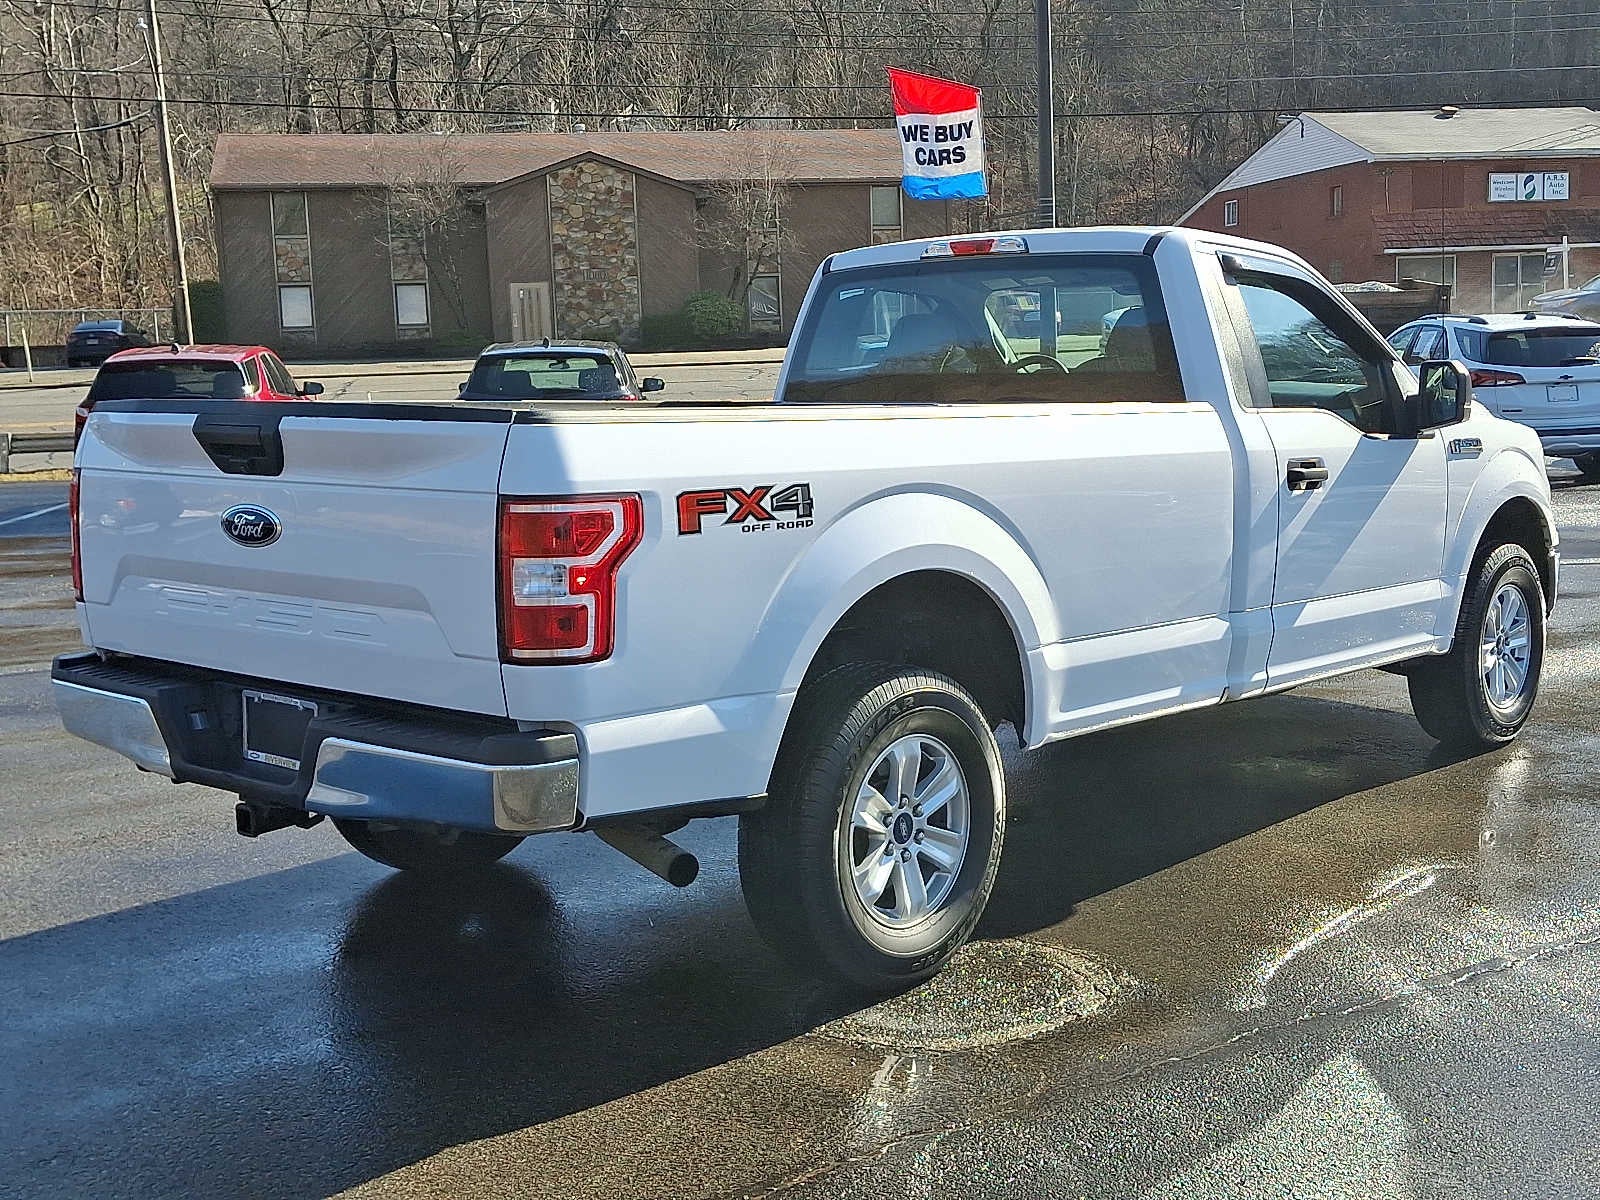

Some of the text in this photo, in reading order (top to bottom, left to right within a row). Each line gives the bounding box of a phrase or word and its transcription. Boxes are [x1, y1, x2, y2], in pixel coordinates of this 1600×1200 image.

[901, 120, 974, 143] WE BUY
[914, 145, 966, 166] CARS
[676, 483, 814, 535] FX4
[231, 513, 264, 538] Ford
[741, 519, 814, 533] OFF ROAD
